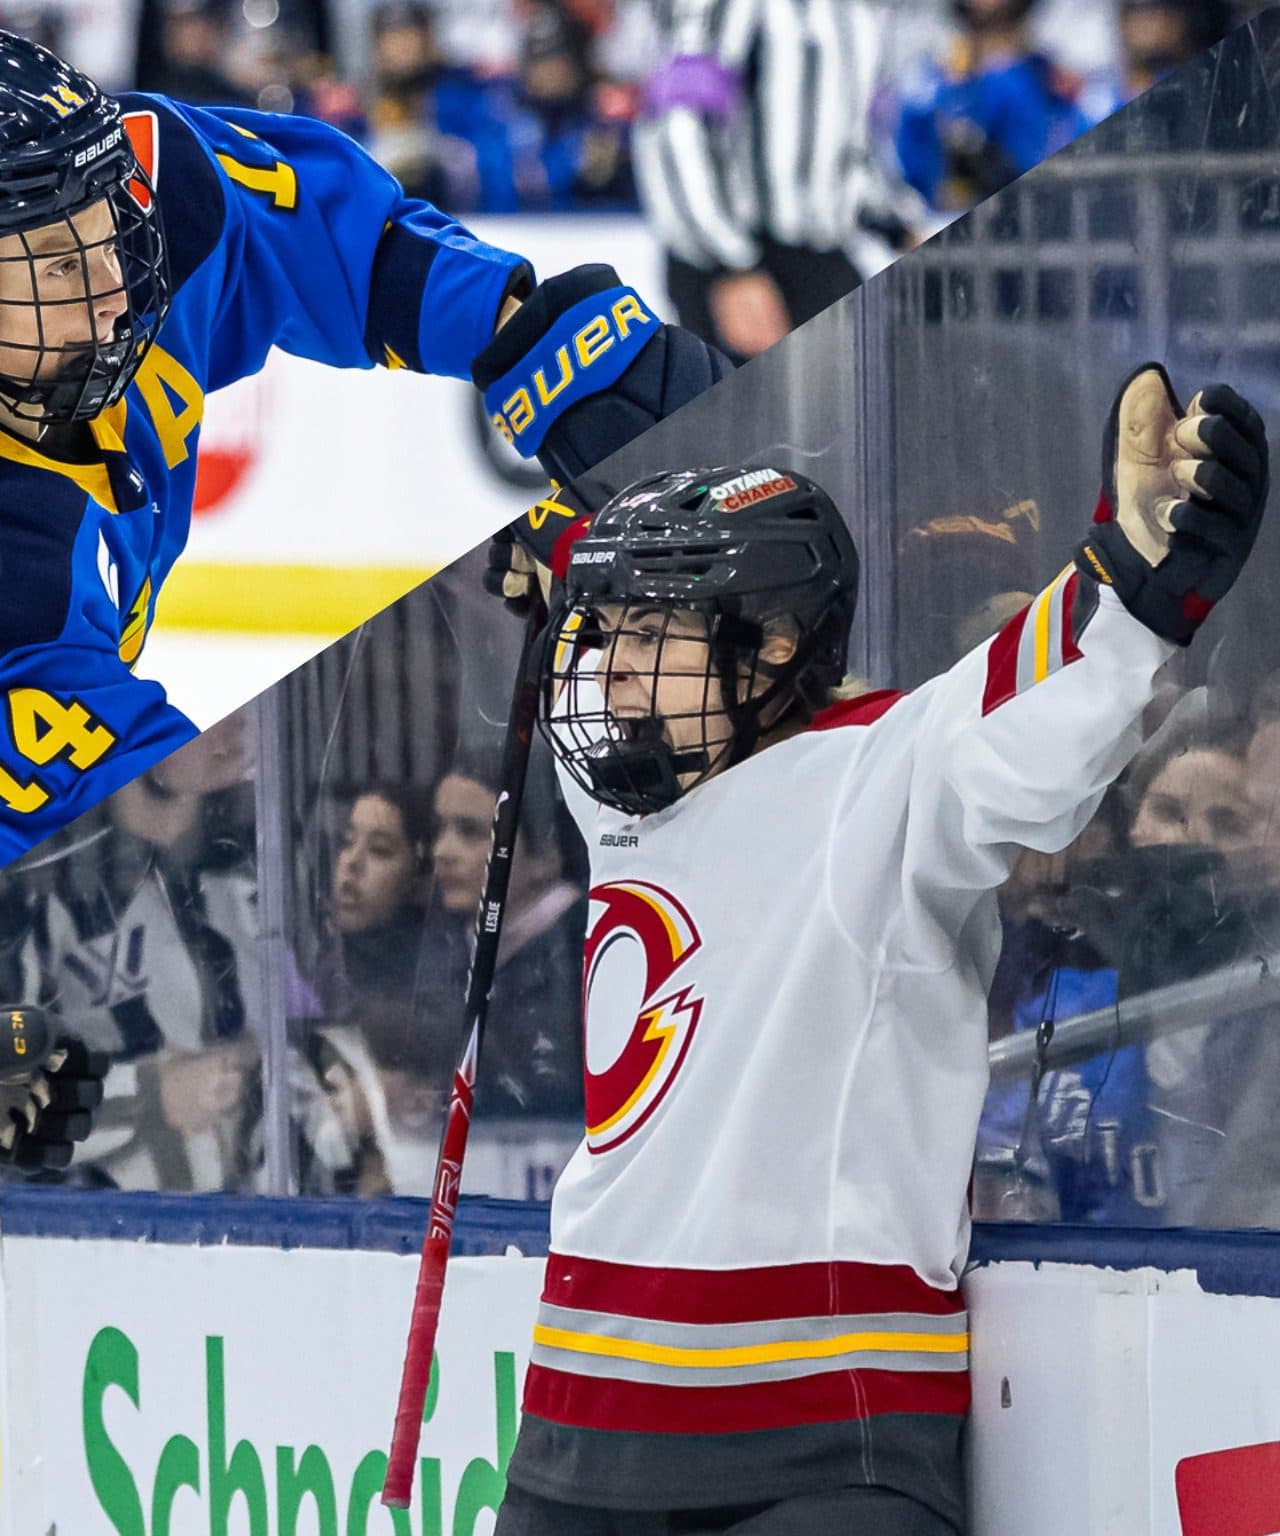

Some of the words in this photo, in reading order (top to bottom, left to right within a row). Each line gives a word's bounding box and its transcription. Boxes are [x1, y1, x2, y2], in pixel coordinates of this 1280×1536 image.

[74, 128, 122, 167] BAUER
[491, 294, 651, 444] BAUER
[710, 468, 784, 501] OTTAWA
[724, 476, 797, 510] CHARGE
[571, 551, 616, 565] BAUER
[600, 833, 639, 848] BAUER
[485, 901, 501, 933] LESLIE
